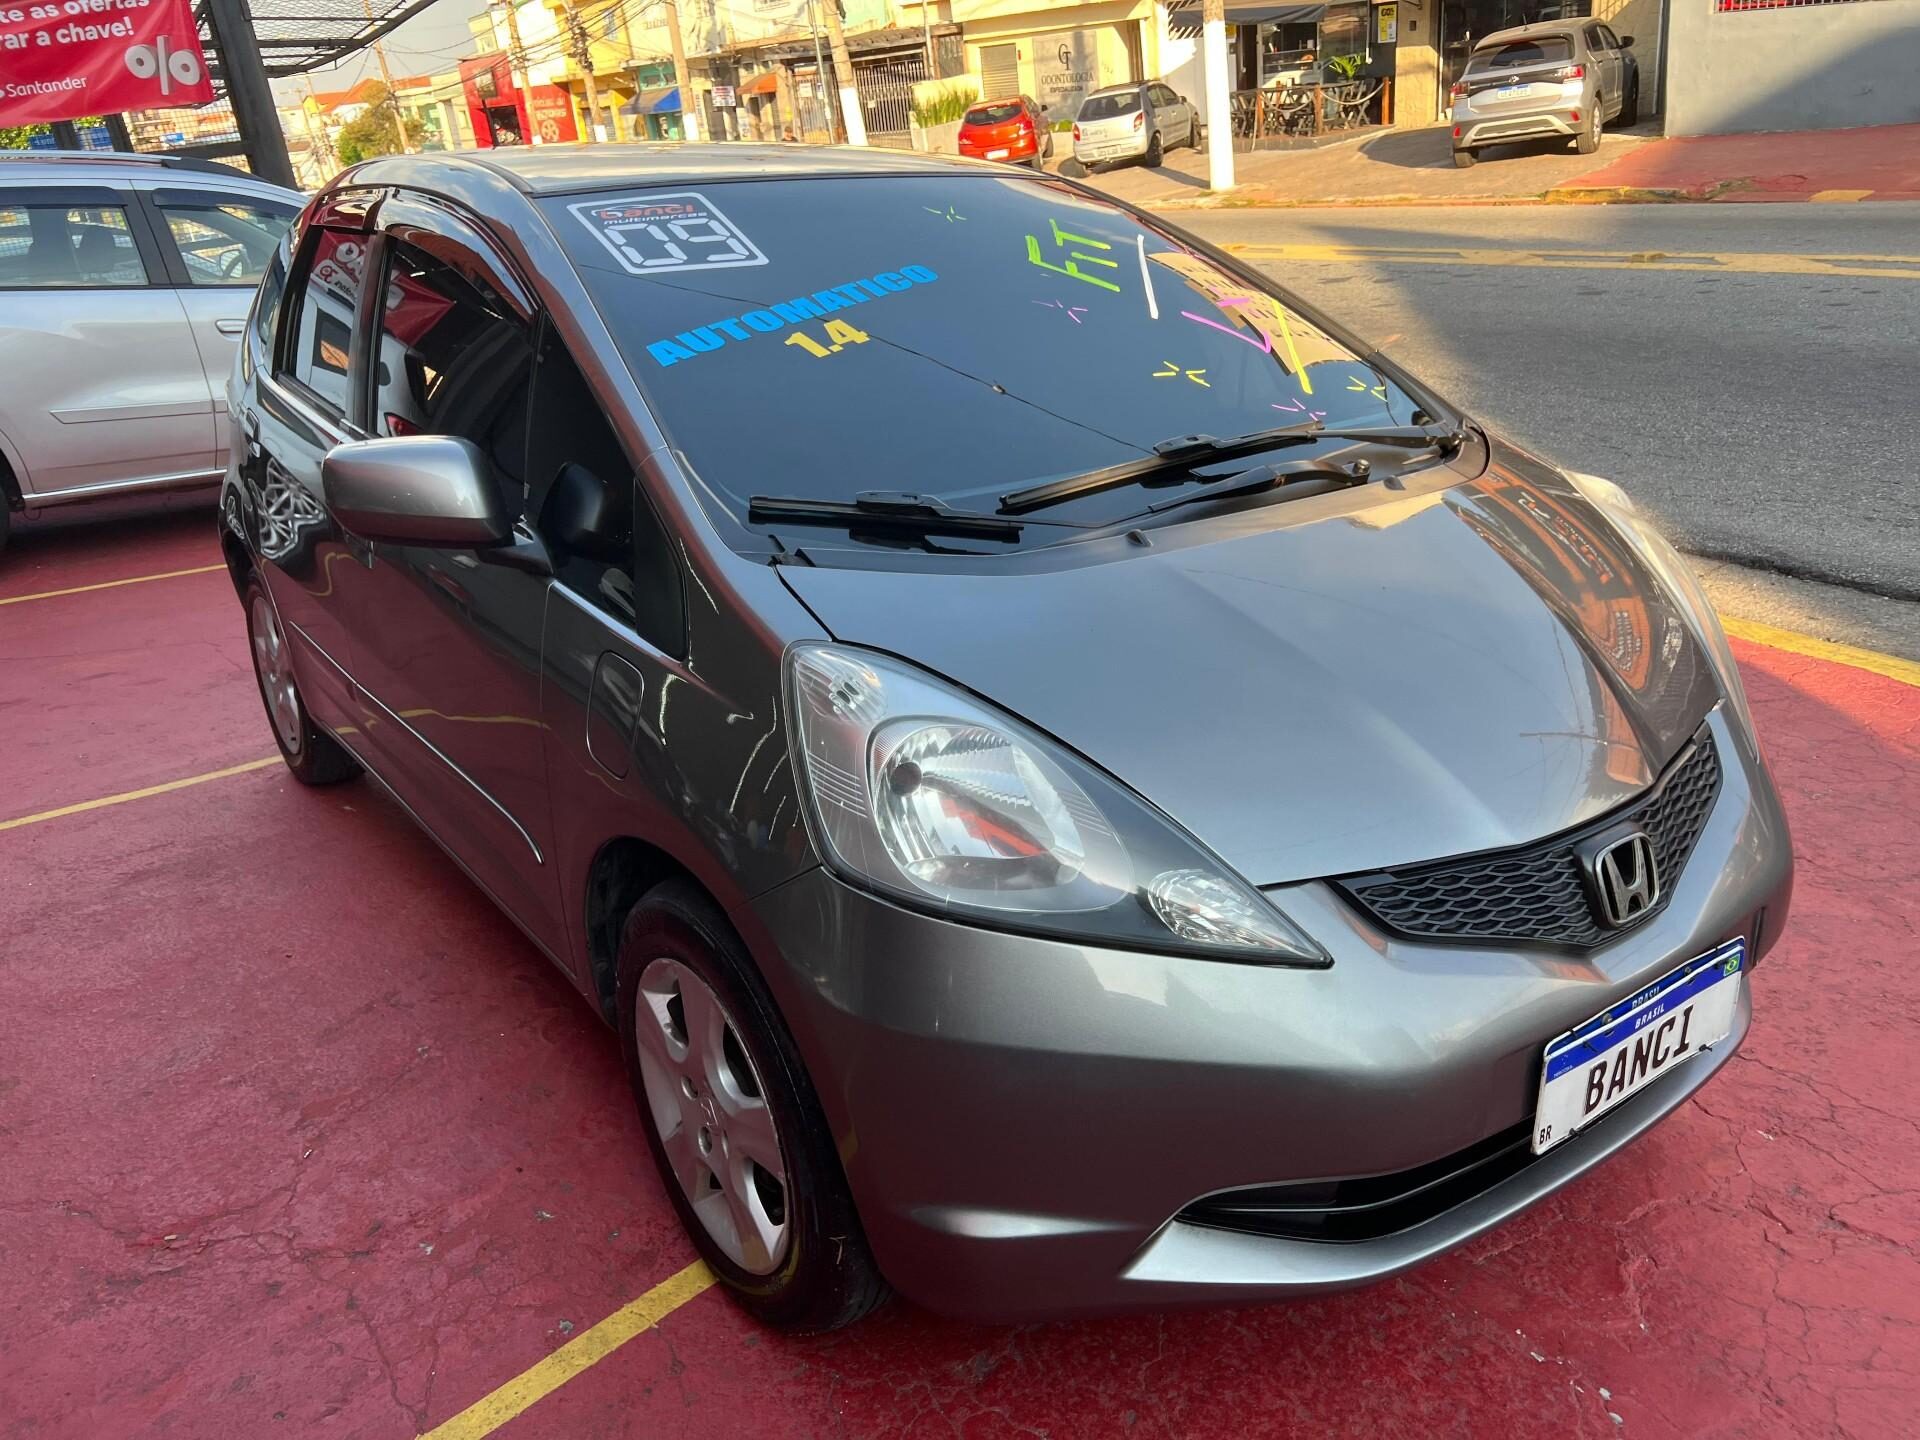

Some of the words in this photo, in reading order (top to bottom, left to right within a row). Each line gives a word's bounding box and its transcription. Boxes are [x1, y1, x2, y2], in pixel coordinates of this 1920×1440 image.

[29, 4, 60, 19] as
[63, 0, 150, 15] ofertas
[35, 30, 52, 46] a
[56, 16, 135, 44] chave!
[6, 77, 87, 98] Santander
[604, 212, 708, 225] multimarcas
[604, 218, 750, 267] 09
[646, 264, 939, 367] AUTOMATICO
[783, 319, 870, 358] 1.4
[1635, 1003, 1664, 1029] BRASIL
[1584, 1005, 1695, 1116] BANCI
[1540, 1125, 1552, 1145] BR
